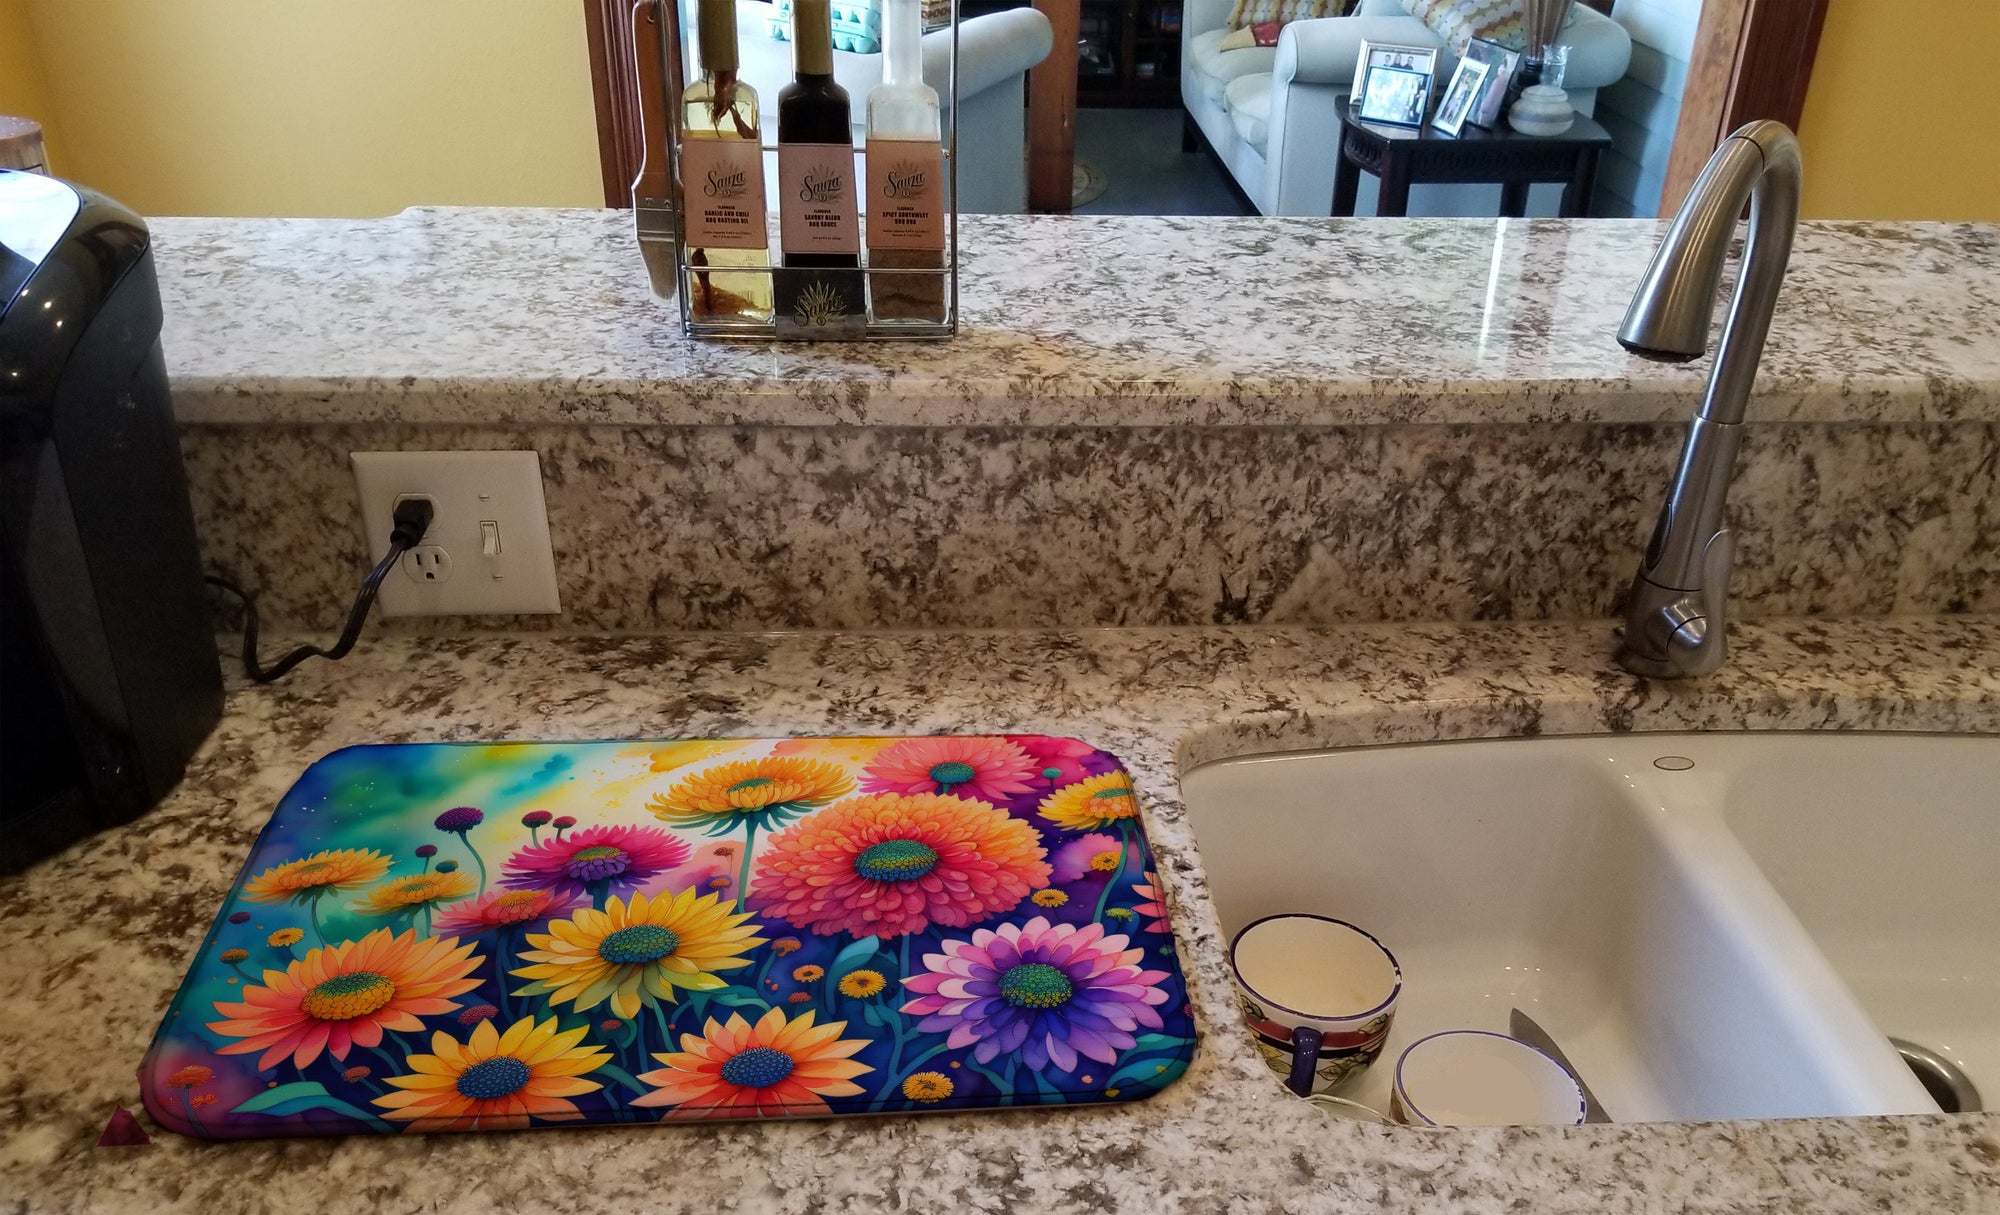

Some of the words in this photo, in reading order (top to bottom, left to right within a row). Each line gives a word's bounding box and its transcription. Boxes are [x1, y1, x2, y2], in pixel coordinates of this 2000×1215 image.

[704, 170, 745, 197] Sauza
[800, 175, 841, 202] Sauza
[884, 171, 925, 198] Sauza
